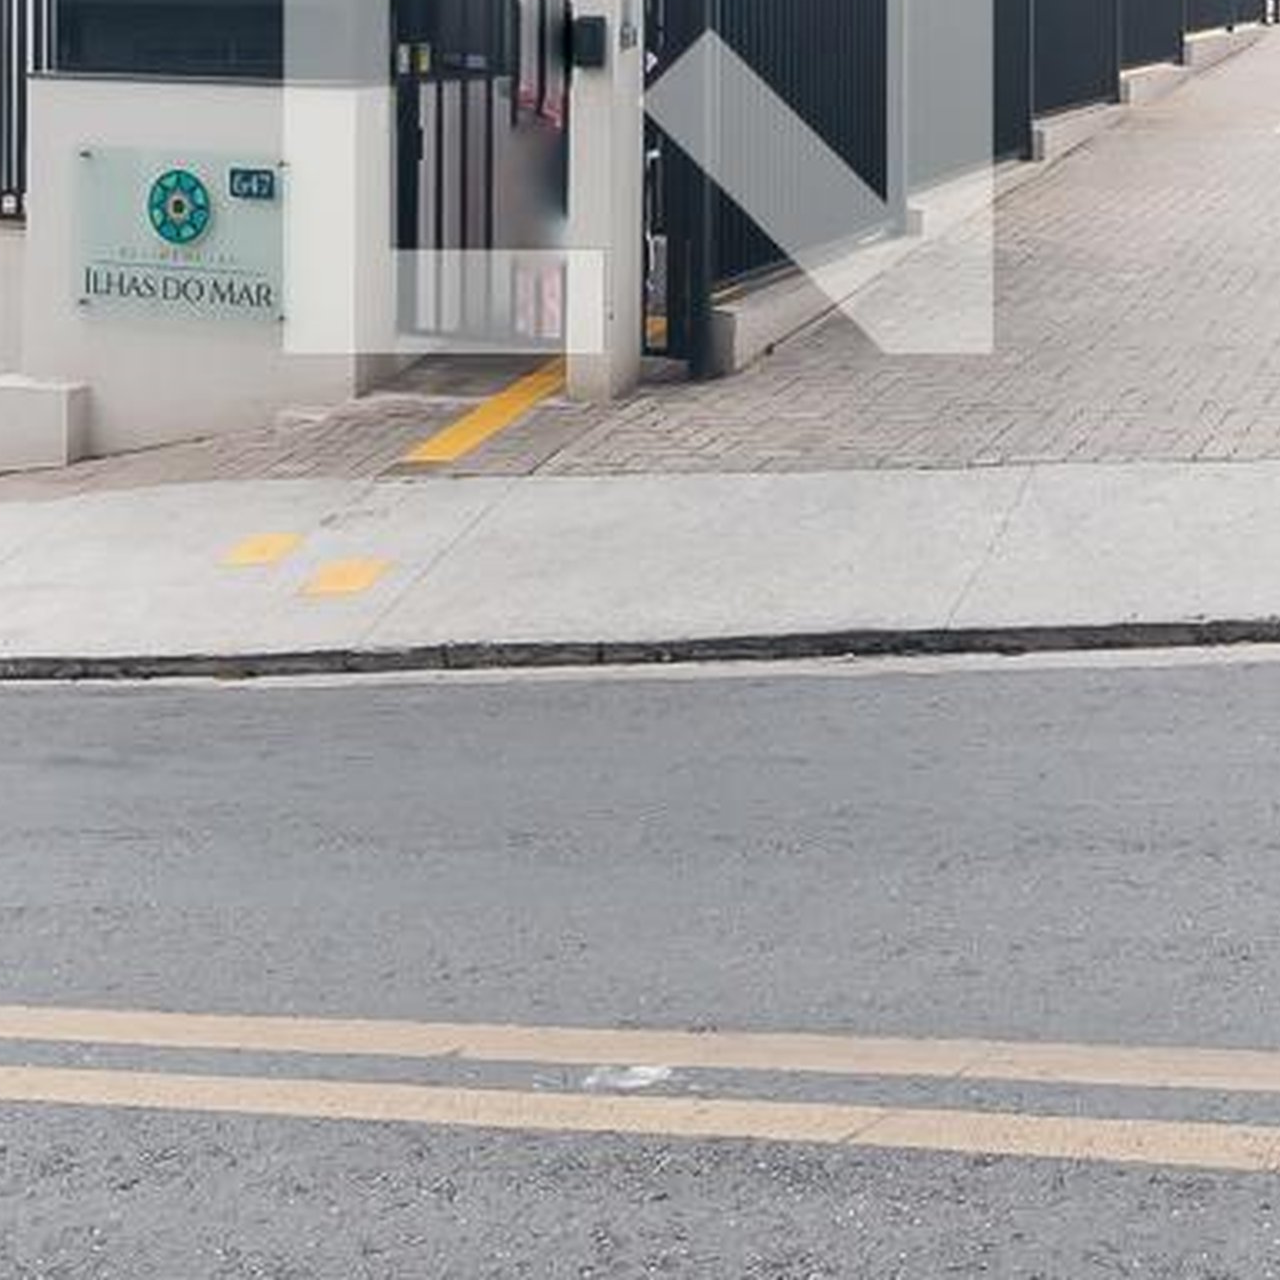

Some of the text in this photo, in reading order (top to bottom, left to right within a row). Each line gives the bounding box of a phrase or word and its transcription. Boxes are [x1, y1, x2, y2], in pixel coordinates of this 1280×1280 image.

[85, 268, 273, 308] ILHAS DO MAR
